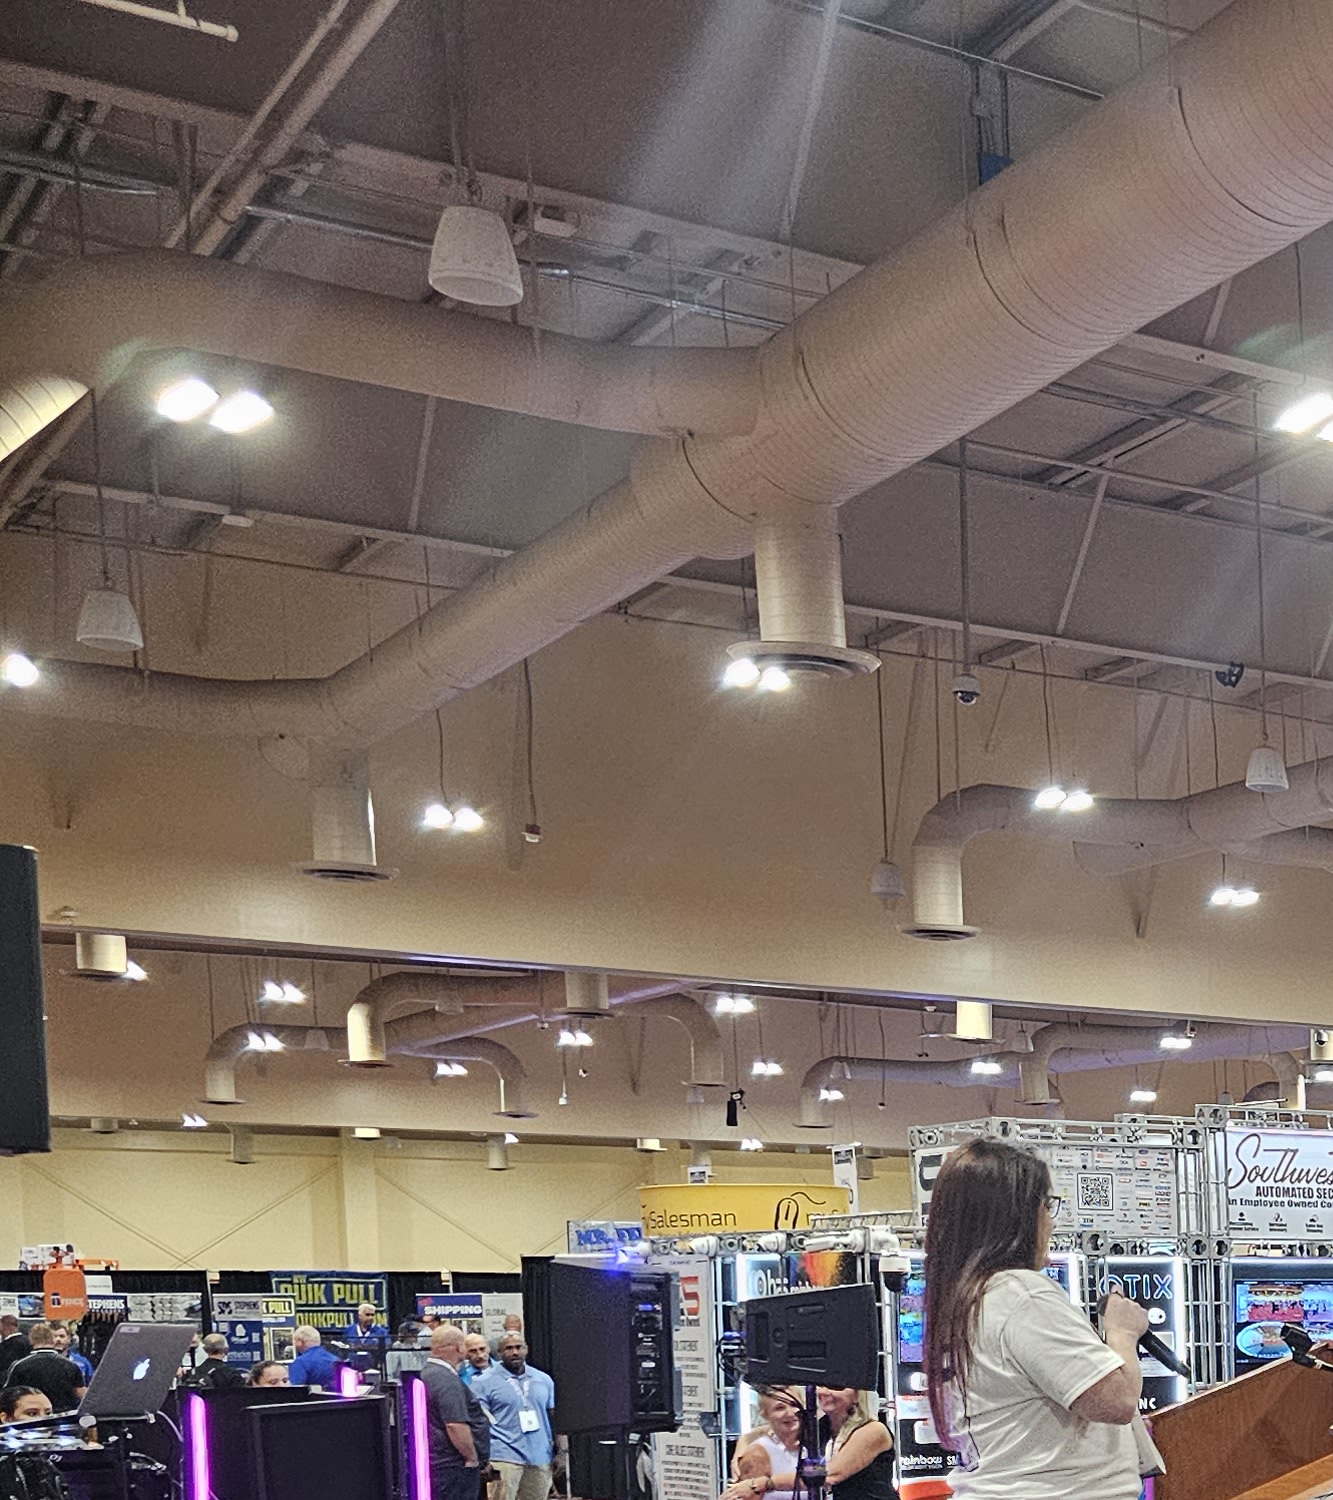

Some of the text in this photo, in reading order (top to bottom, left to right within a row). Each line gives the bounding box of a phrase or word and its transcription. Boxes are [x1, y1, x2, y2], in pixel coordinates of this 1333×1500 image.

[1255, 1186, 1313, 1199] AUTOMATED
[1240, 1198, 1285, 1208] Employee
[1287, 1199, 1318, 1208] Owned
[333, 1283, 378, 1304] PULL
[88, 1298, 125, 1310] TEPHENS
[424, 1305, 482, 1315] SHIPPING
